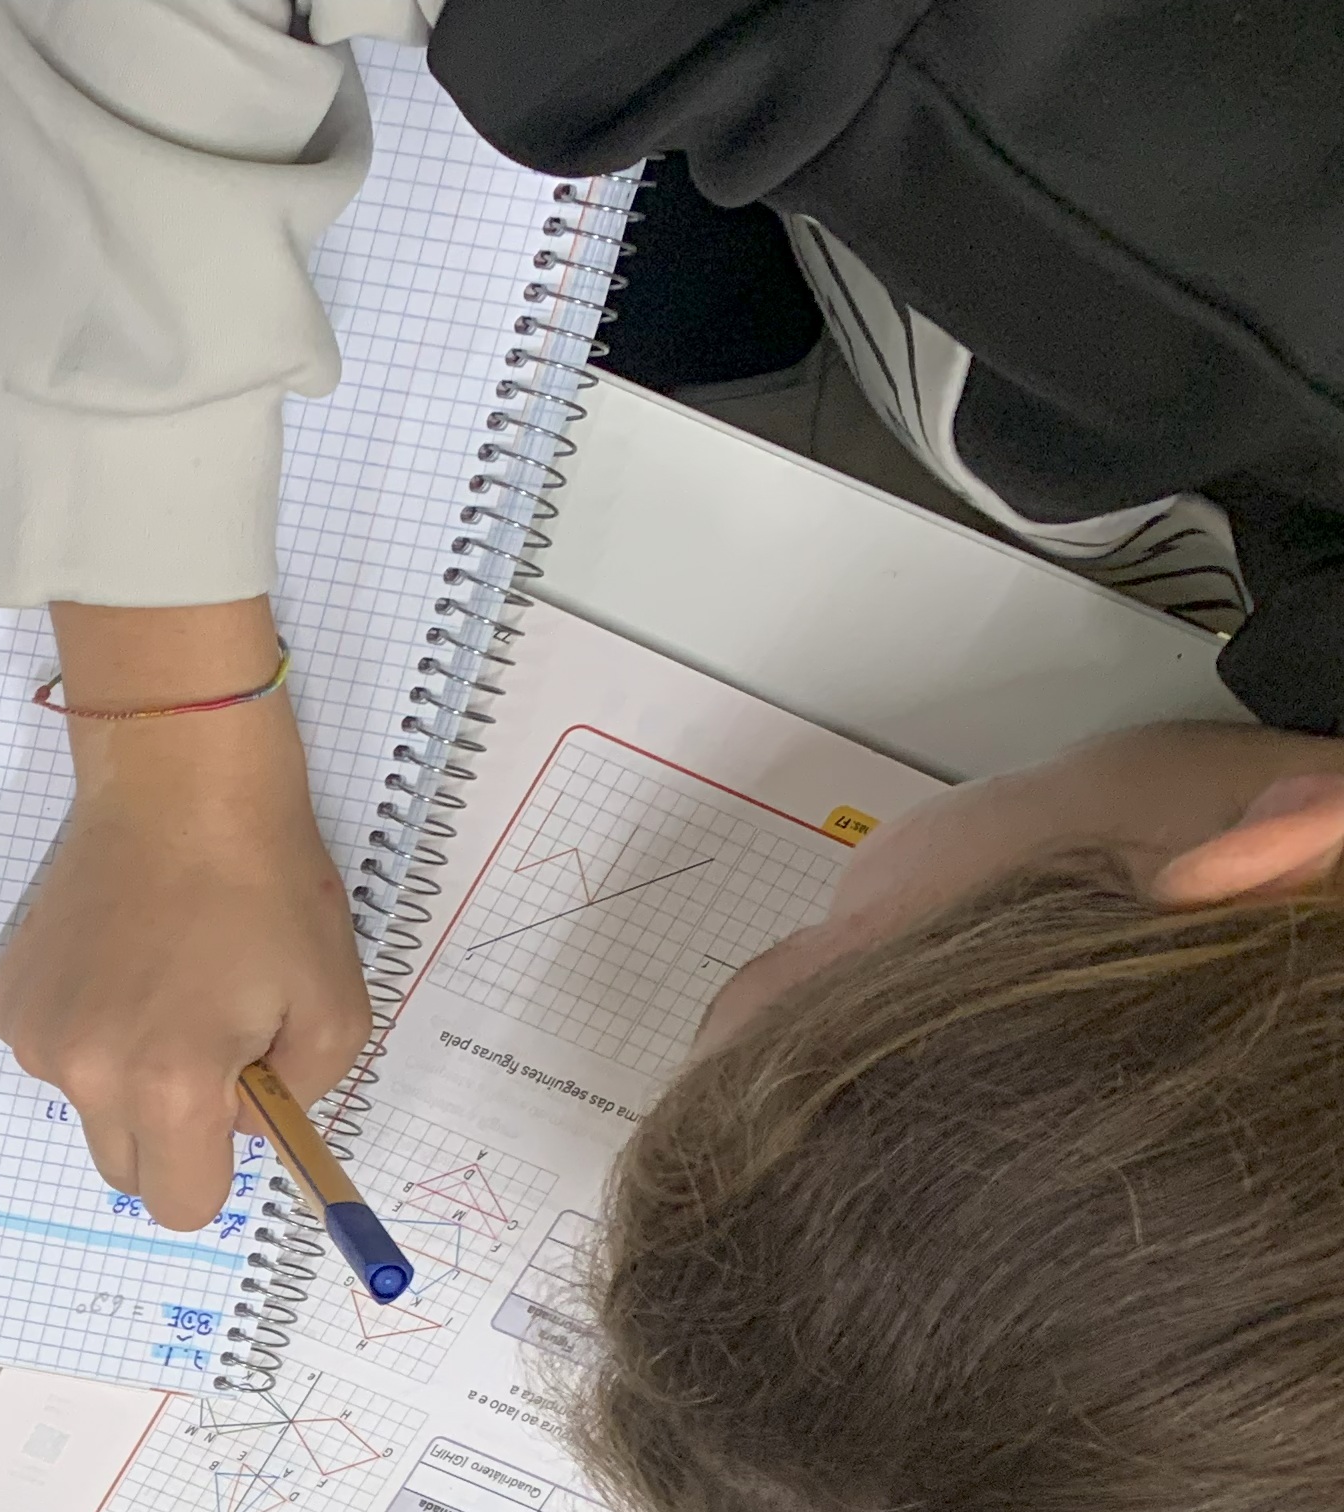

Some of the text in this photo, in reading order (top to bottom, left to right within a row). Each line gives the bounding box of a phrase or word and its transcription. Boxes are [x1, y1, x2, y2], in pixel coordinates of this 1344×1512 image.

[834, 815, 851, 829] F7
[439, 1030, 473, 1050] pela
[470, 1044, 520, 1074] figuras
[520, 1065, 589, 1100] seguintes
[588, 1094, 615, 1113] das
[429, 1443, 541, 1498] Quadrilátero [GHIF]
